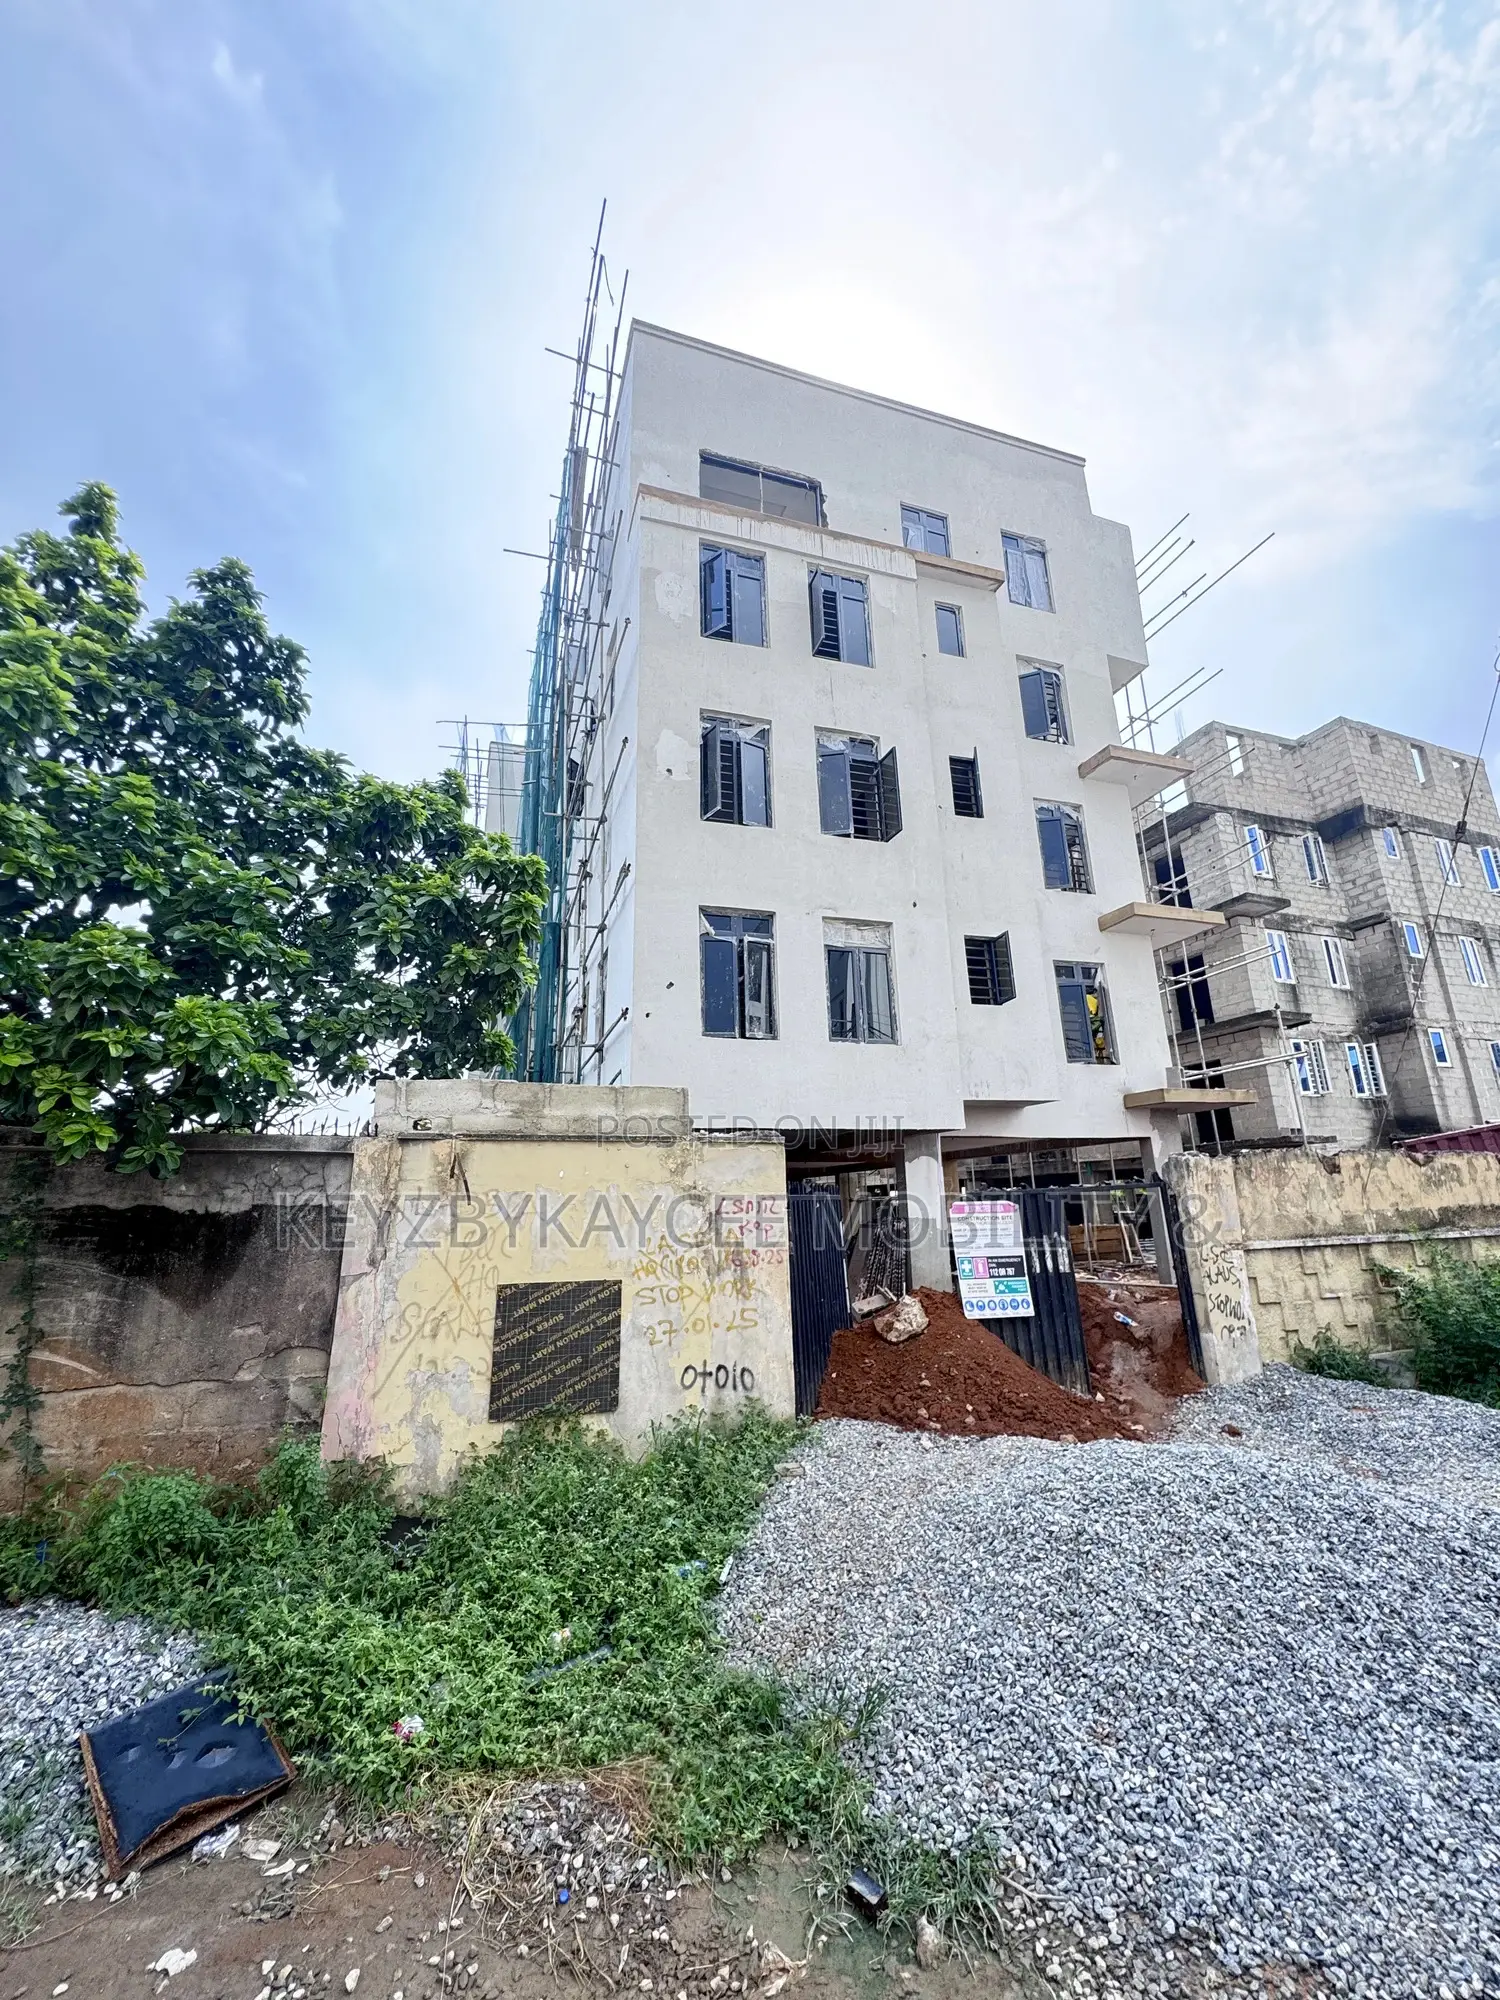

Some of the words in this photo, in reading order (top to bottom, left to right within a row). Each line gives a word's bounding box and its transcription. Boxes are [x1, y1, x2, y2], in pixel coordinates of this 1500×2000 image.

[574, 1295, 597, 1313] MART
[635, 1283, 694, 1312] STOP
[513, 1301, 537, 1319] MART
[536, 1312, 564, 1332] SUPER
[556, 1323, 595, 1348] YEKALON
[531, 1344, 556, 1362] MART
[592, 1338, 615, 1356] MART
[491, 1362, 521, 1383] SUPER
[554, 1355, 583, 1375] SUPER
[511, 1373, 554, 1399] YEKALON
[574, 1366, 614, 1391] YEKALON
[489, 1395, 511, 1412] MAR
[574, 1398, 601, 1417] SUPE
